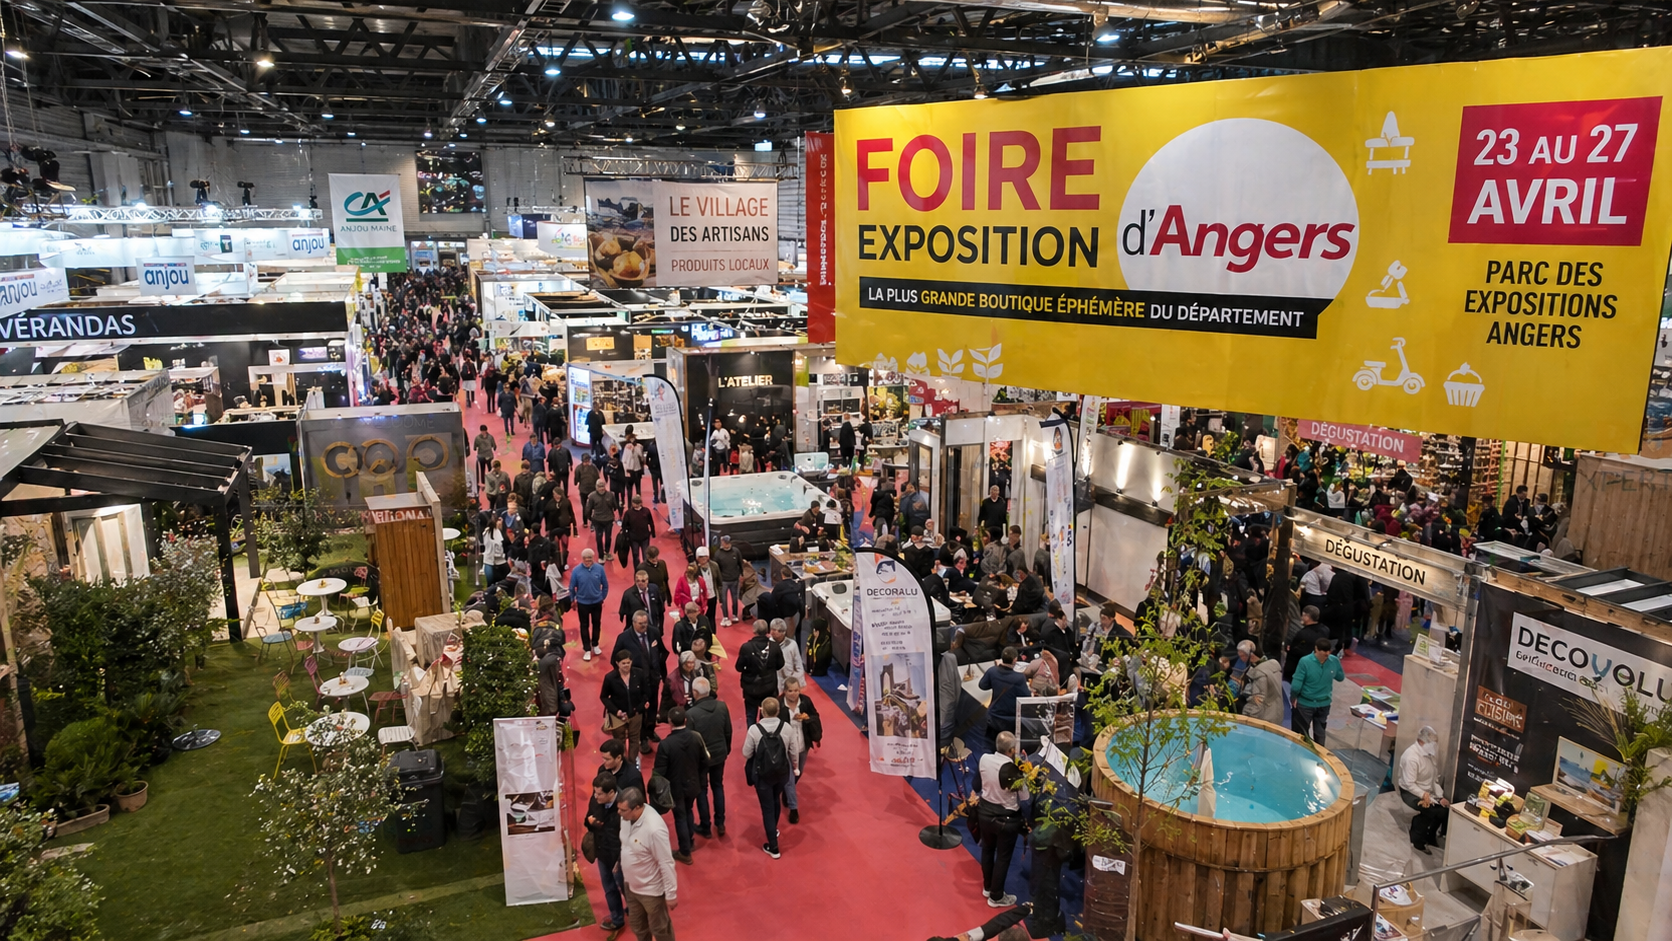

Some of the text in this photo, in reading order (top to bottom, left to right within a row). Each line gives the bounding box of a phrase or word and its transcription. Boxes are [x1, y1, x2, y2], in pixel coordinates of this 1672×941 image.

[1473, 123, 1638, 166] 23 AU 27
[856, 125, 1101, 212] FOIRE
[670, 196, 768, 217] LE VILLAGE
[1466, 177, 1628, 225] AVRIL
[370, 225, 398, 233] MAINE
[670, 226, 770, 242] DES ARTISANS
[1122, 204, 1355, 273] d'Angers
[292, 234, 325, 254] anjou
[858, 224, 1099, 268] EXPOSITION
[144, 266, 190, 290] anjou
[671, 258, 770, 272] PRODUITS LOCAUX
[1485, 260, 1604, 287] PARC DES
[868, 286, 1304, 327] LA PLUS GRANDE BOUTIQUE ÉPHÉMÈRE DU DÉPARTEMENT
[1464, 290, 1618, 319] EXPOSITIONS
[0, 312, 136, 339] VÉRANDAS
[1486, 321, 1582, 349] ANGERS
[718, 374, 774, 388] L'ATELIER
[1311, 420, 1405, 453] DÉGUSTATION
[1325, 538, 1426, 585] DÉGUSTATION
[866, 587, 918, 597] DECORALU
